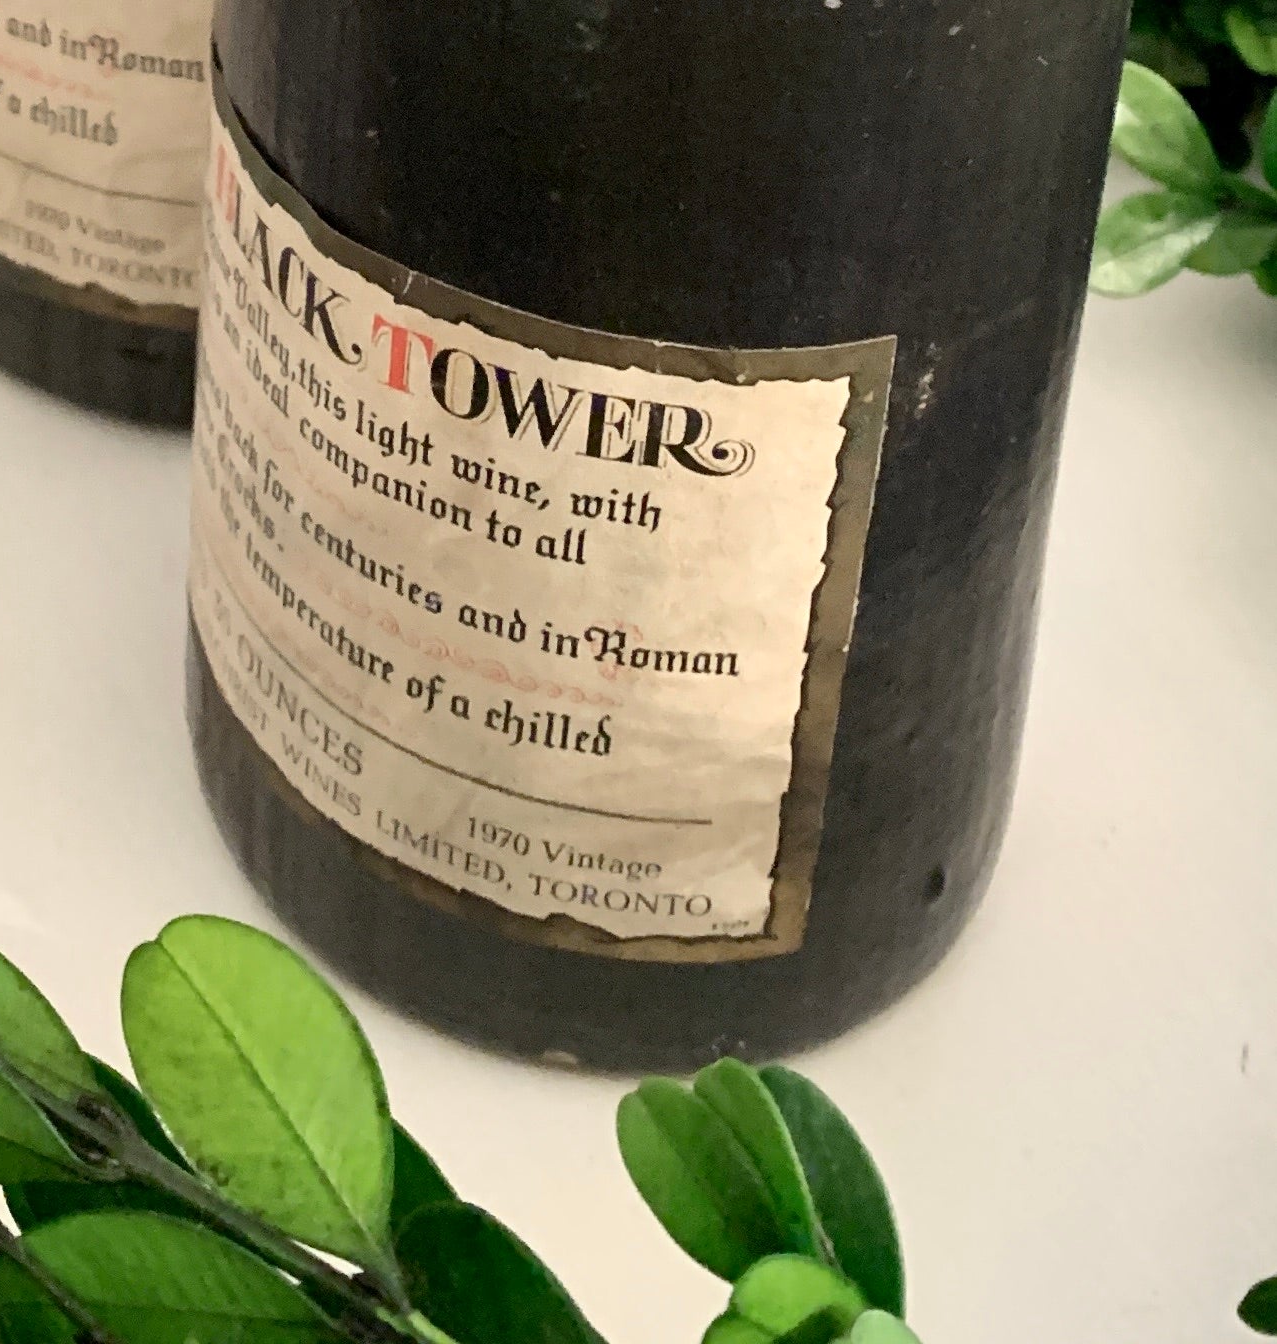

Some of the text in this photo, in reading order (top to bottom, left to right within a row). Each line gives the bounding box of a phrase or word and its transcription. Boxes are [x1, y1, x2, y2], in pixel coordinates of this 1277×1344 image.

[296, 357, 348, 423] this
[355, 398, 435, 468] light
[451, 453, 551, 511] wine,
[570, 488, 662, 534] with
[371, 312, 756, 478] TOWER
[299, 417, 473, 533] companion
[486, 509, 523, 549] to
[535, 527, 587, 565] all
[245, 530, 395, 685] temperature
[405, 674, 447, 712] of
[450, 693, 471, 721] a
[485, 705, 613, 758] chilled
[300, 511, 443, 615] centuries
[458, 609, 527, 644] and
[541, 621, 581, 660] in
[583, 623, 740, 680] Roman
[236, 632, 364, 777] OUNCES
[376, 809, 513, 892] LIMITED,
[527, 872, 713, 918] TORONTO
[467, 816, 663, 881] 1970 Vintage
